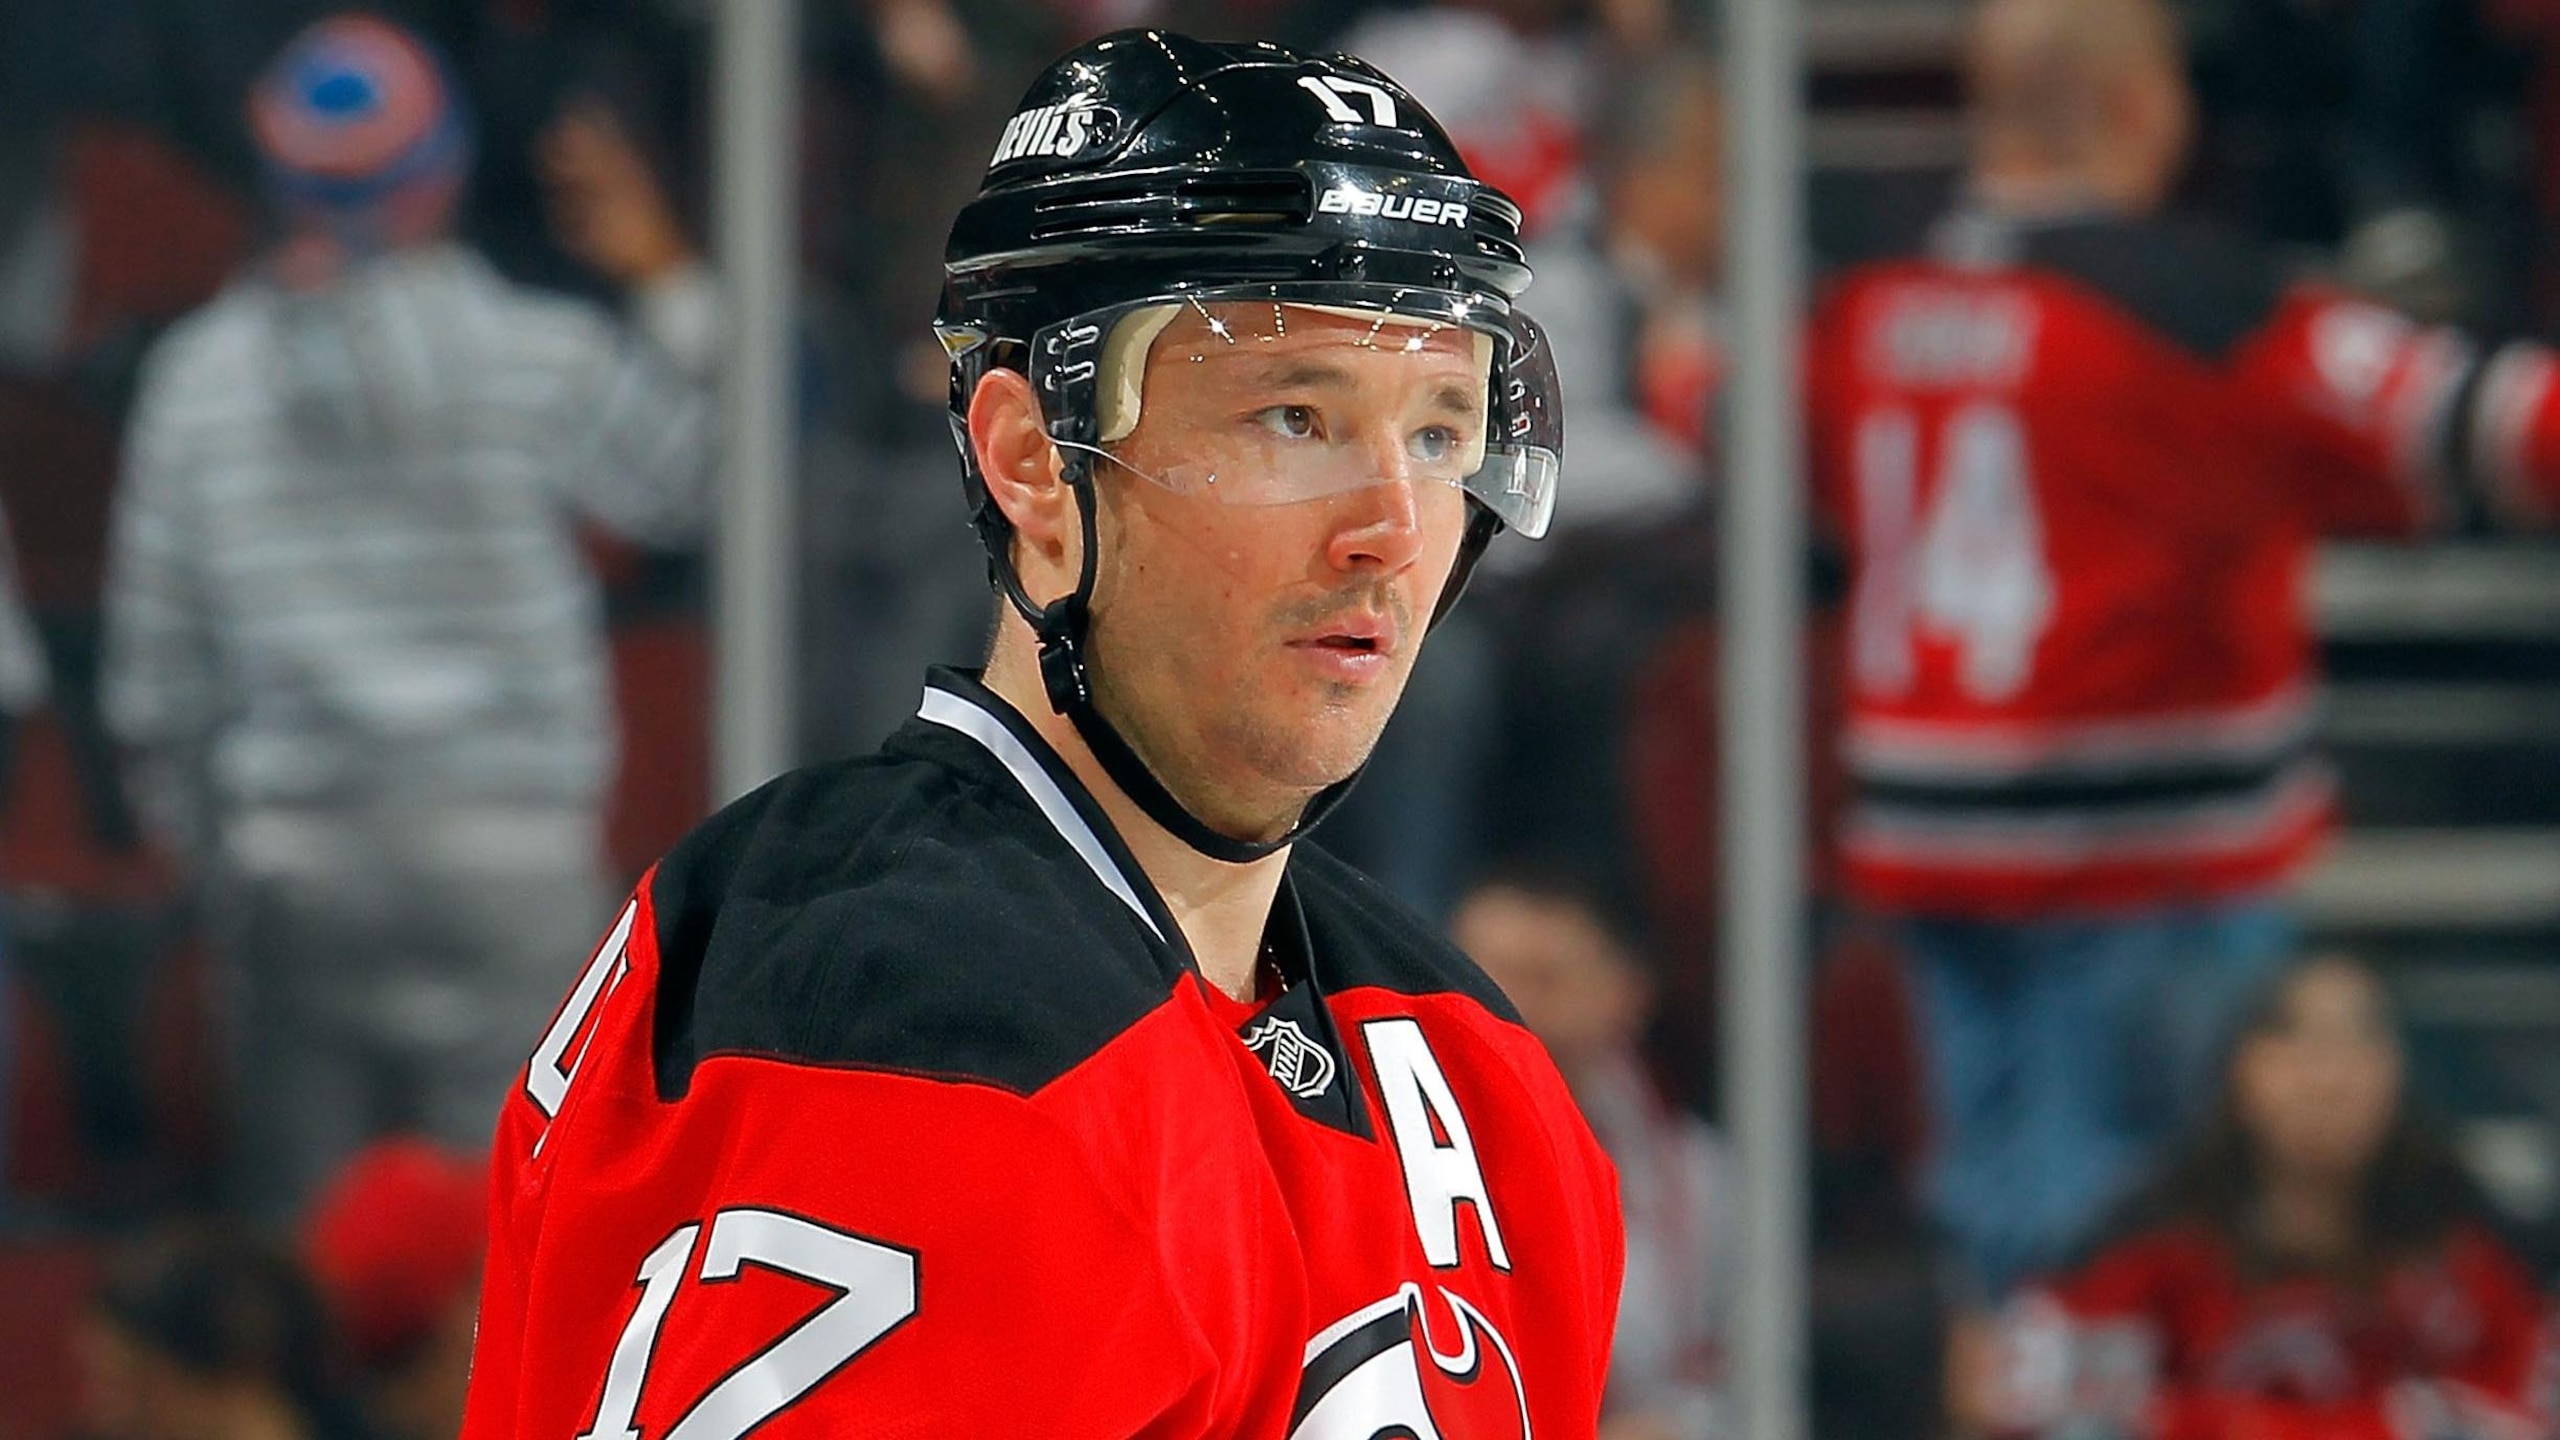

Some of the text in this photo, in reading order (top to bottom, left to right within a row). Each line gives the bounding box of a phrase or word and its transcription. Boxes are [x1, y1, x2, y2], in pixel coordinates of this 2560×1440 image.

[1297, 75, 1397, 128] 17
[1318, 188, 1468, 229] BAUER
[1850, 402, 2058, 702] 14
[1274, 1037, 1299, 1088] NHL
[1362, 1018, 1512, 1273] A
[577, 1205, 920, 1440] 17
